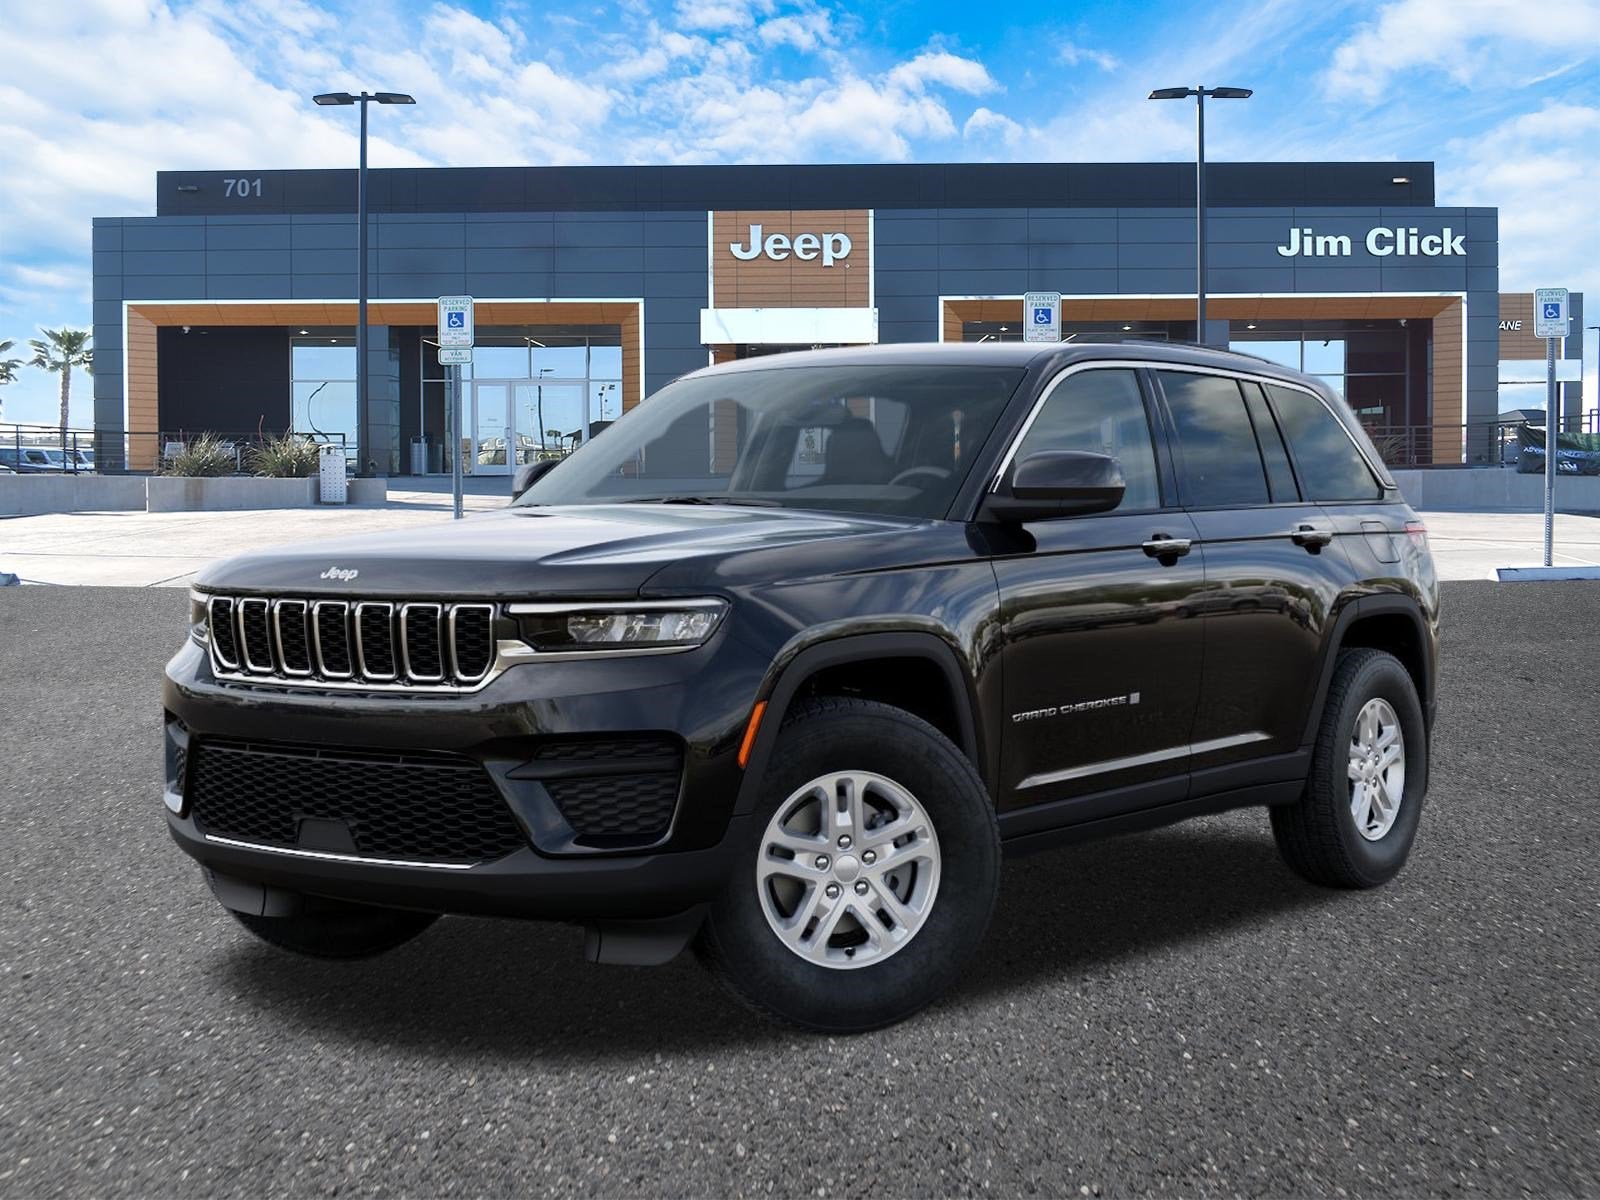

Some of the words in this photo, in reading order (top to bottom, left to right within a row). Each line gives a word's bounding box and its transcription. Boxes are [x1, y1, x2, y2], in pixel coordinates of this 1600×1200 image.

[223, 178, 261, 197] 701
[730, 224, 852, 267] Jeep
[1277, 228, 1351, 257] Jim
[1365, 227, 1467, 257] Click
[320, 566, 359, 581] Jeep
[1012, 707, 1057, 722] GRAND
[1060, 696, 1127, 714] CHEROKEE
